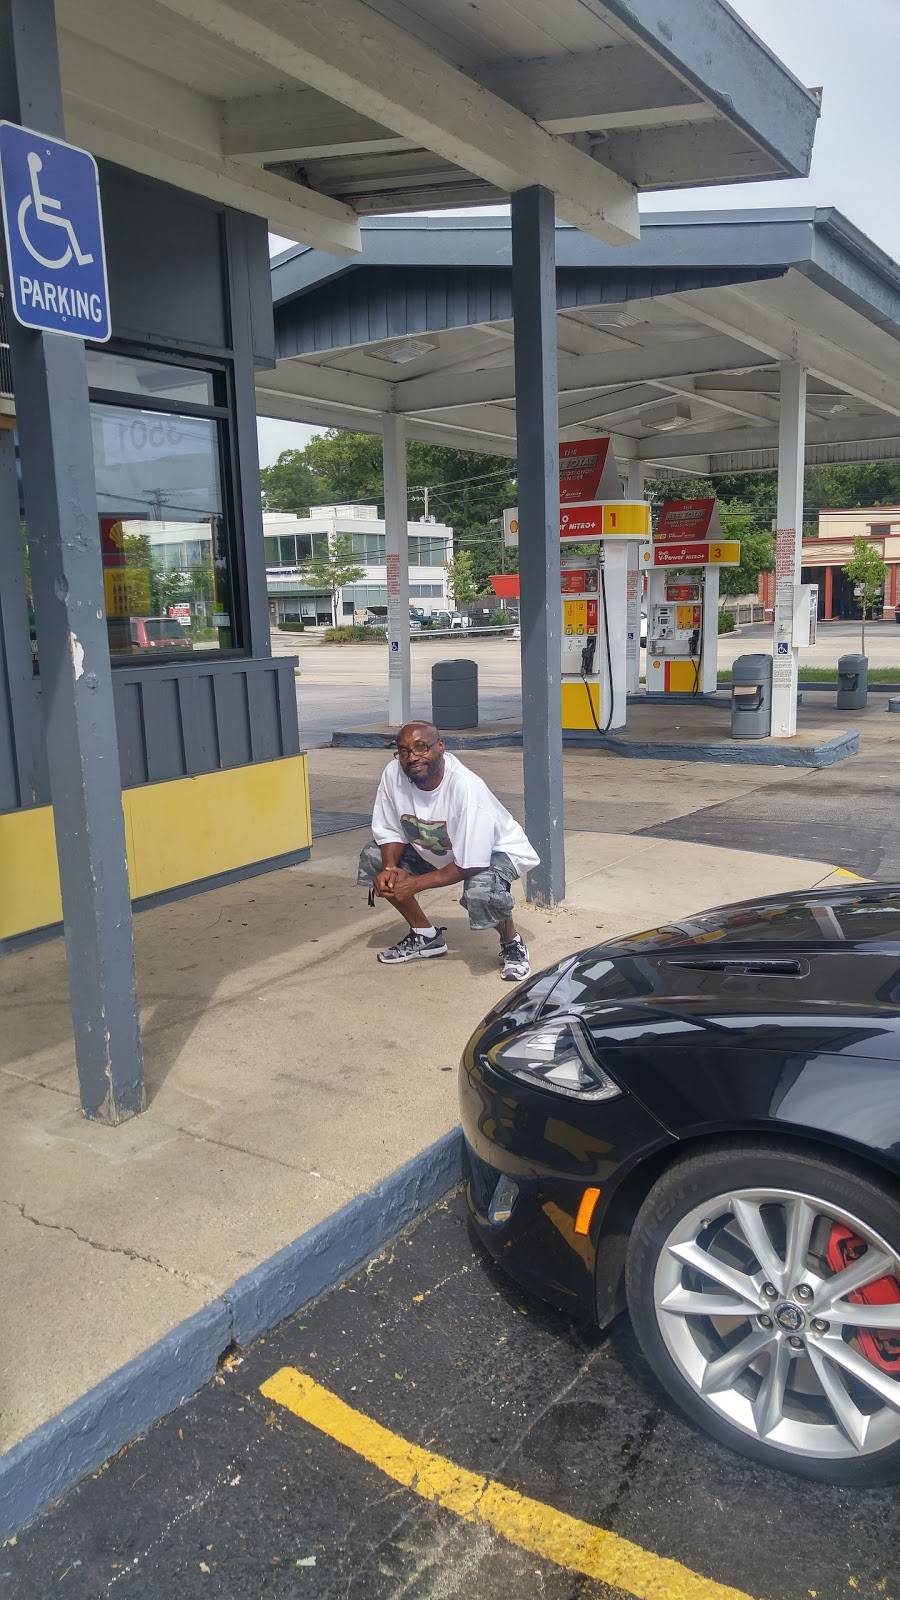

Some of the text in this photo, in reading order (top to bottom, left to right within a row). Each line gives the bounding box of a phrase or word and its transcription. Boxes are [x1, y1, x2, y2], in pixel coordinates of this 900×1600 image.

[20, 275, 102, 323] PARKING
[609, 512, 617, 528] 1
[714, 548, 722, 558] 3
